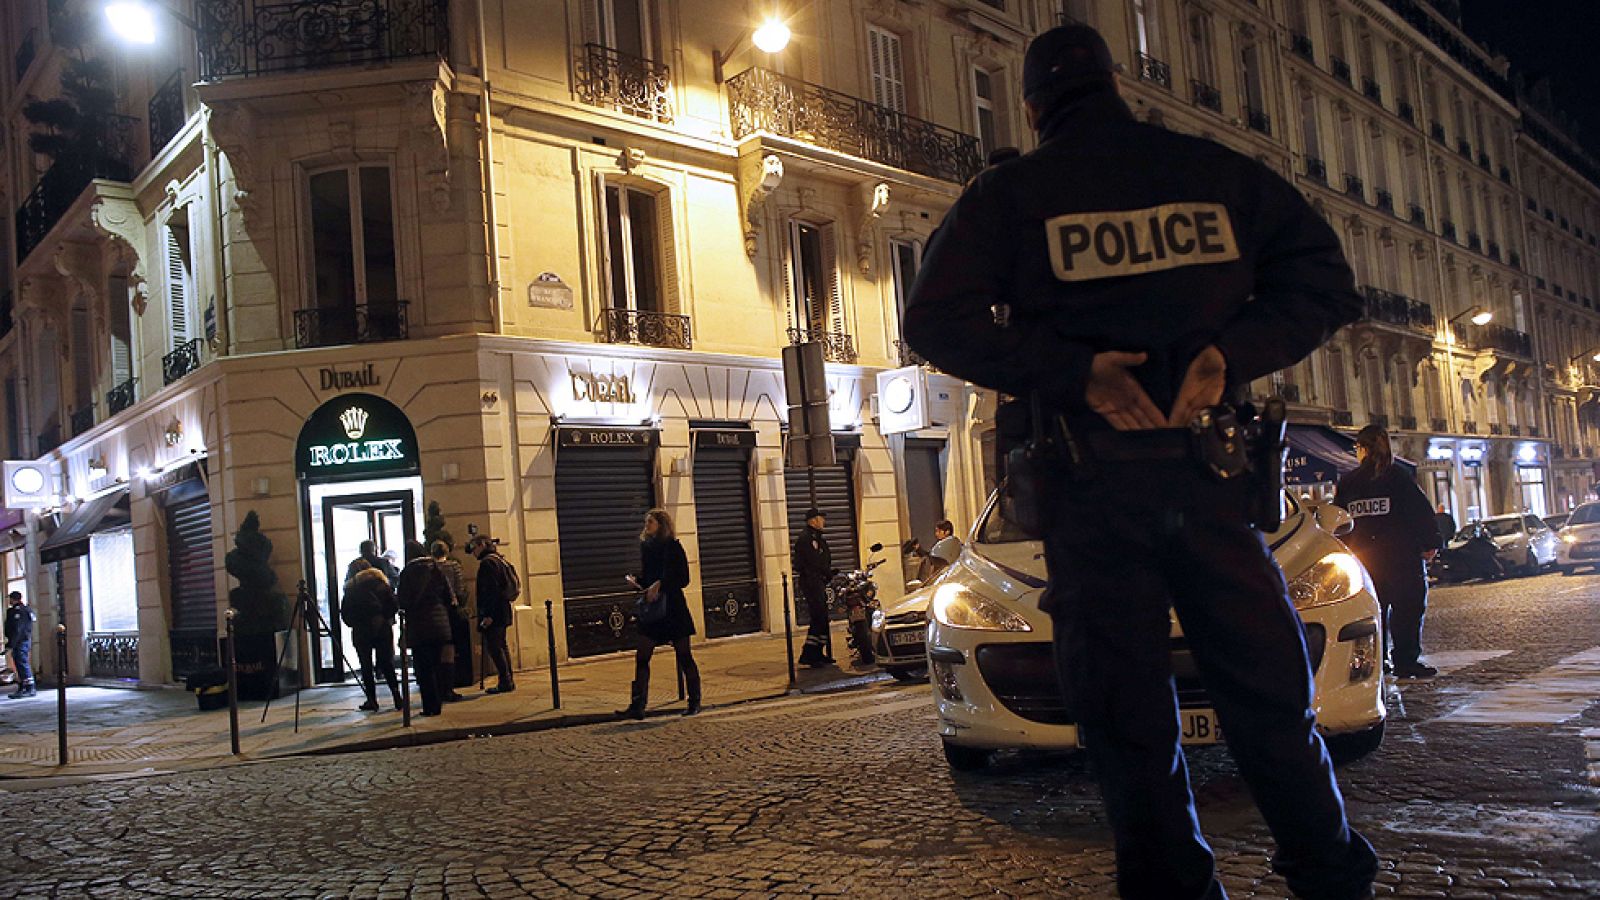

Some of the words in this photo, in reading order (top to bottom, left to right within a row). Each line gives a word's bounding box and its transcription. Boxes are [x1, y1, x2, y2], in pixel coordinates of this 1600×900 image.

[1059, 212, 1225, 271] POLICE
[319, 364, 380, 391] DUBAIL
[589, 432, 635, 444] ROLEX
[309, 438, 404, 467] ROLEX
[1350, 500, 1387, 514] POLICE
